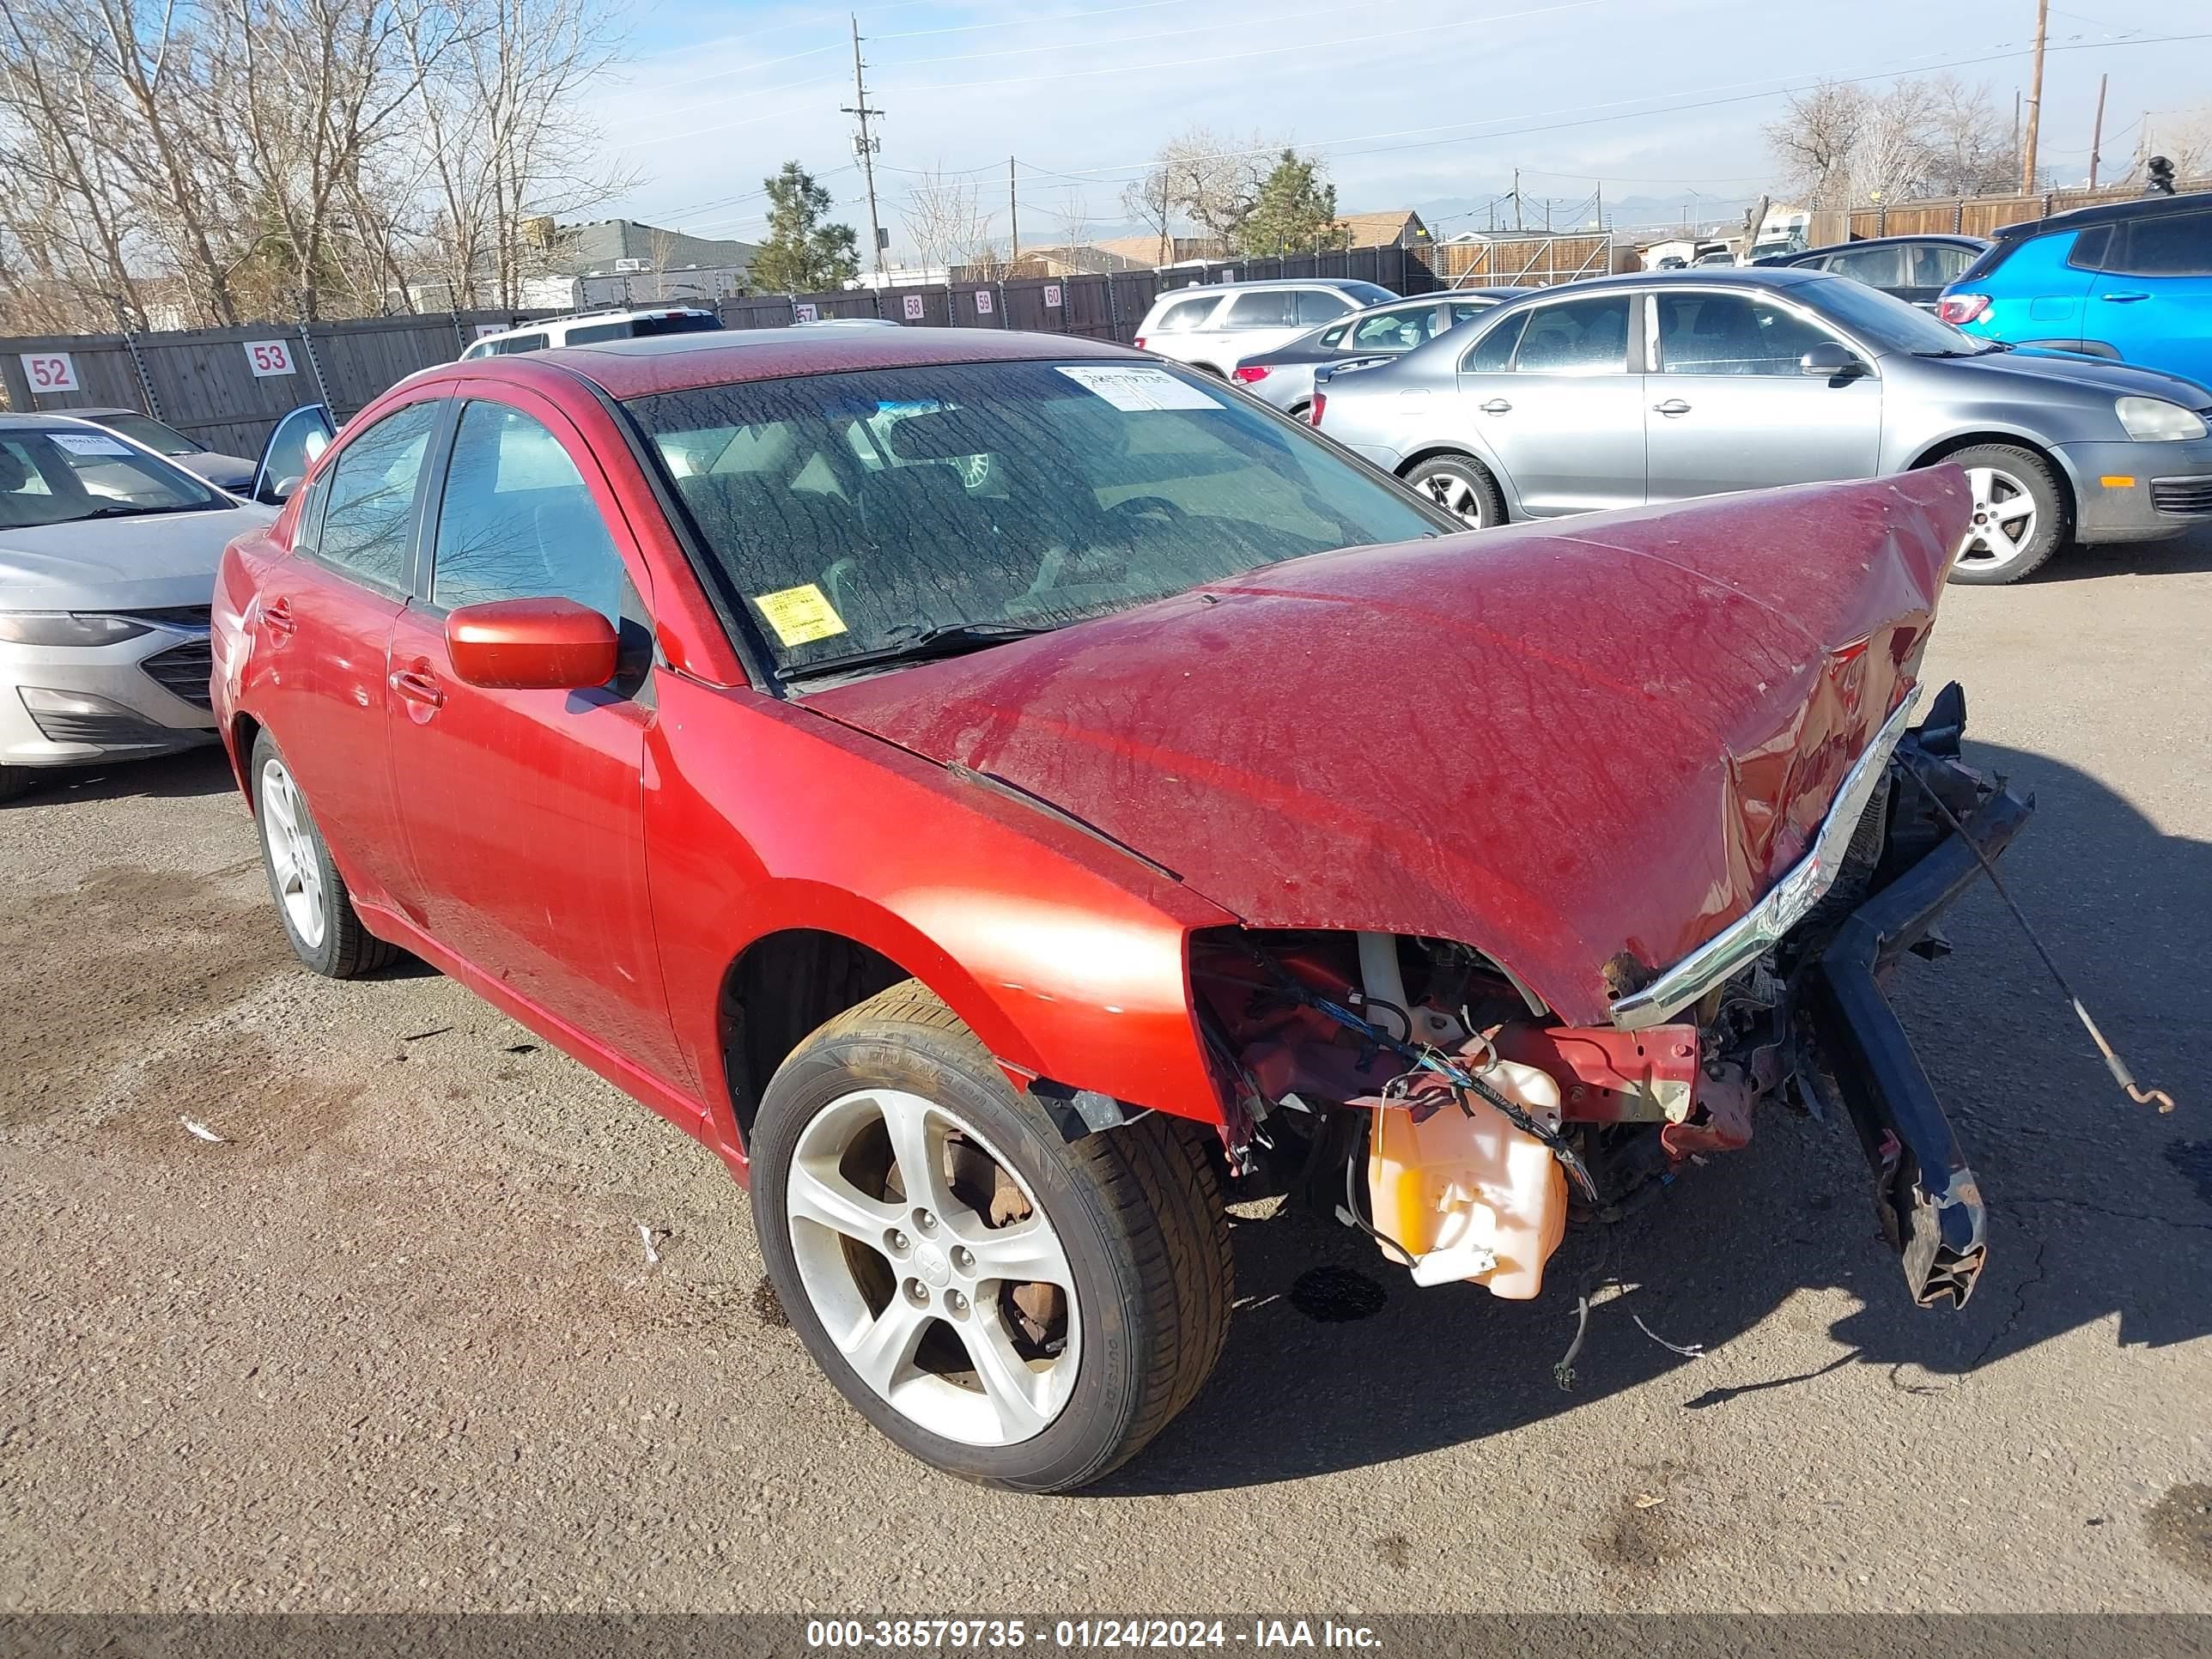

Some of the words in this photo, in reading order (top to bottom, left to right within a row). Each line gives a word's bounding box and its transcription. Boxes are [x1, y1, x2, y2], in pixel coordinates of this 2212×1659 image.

[978, 295, 990, 310] 59
[1047, 289, 1059, 303] 60
[797, 307, 813, 322] 57
[907, 298, 921, 315] 58
[253, 345, 287, 371] 53
[32, 359, 70, 386] 52
[1103, 1338, 1119, 1411] OUTSIDE
